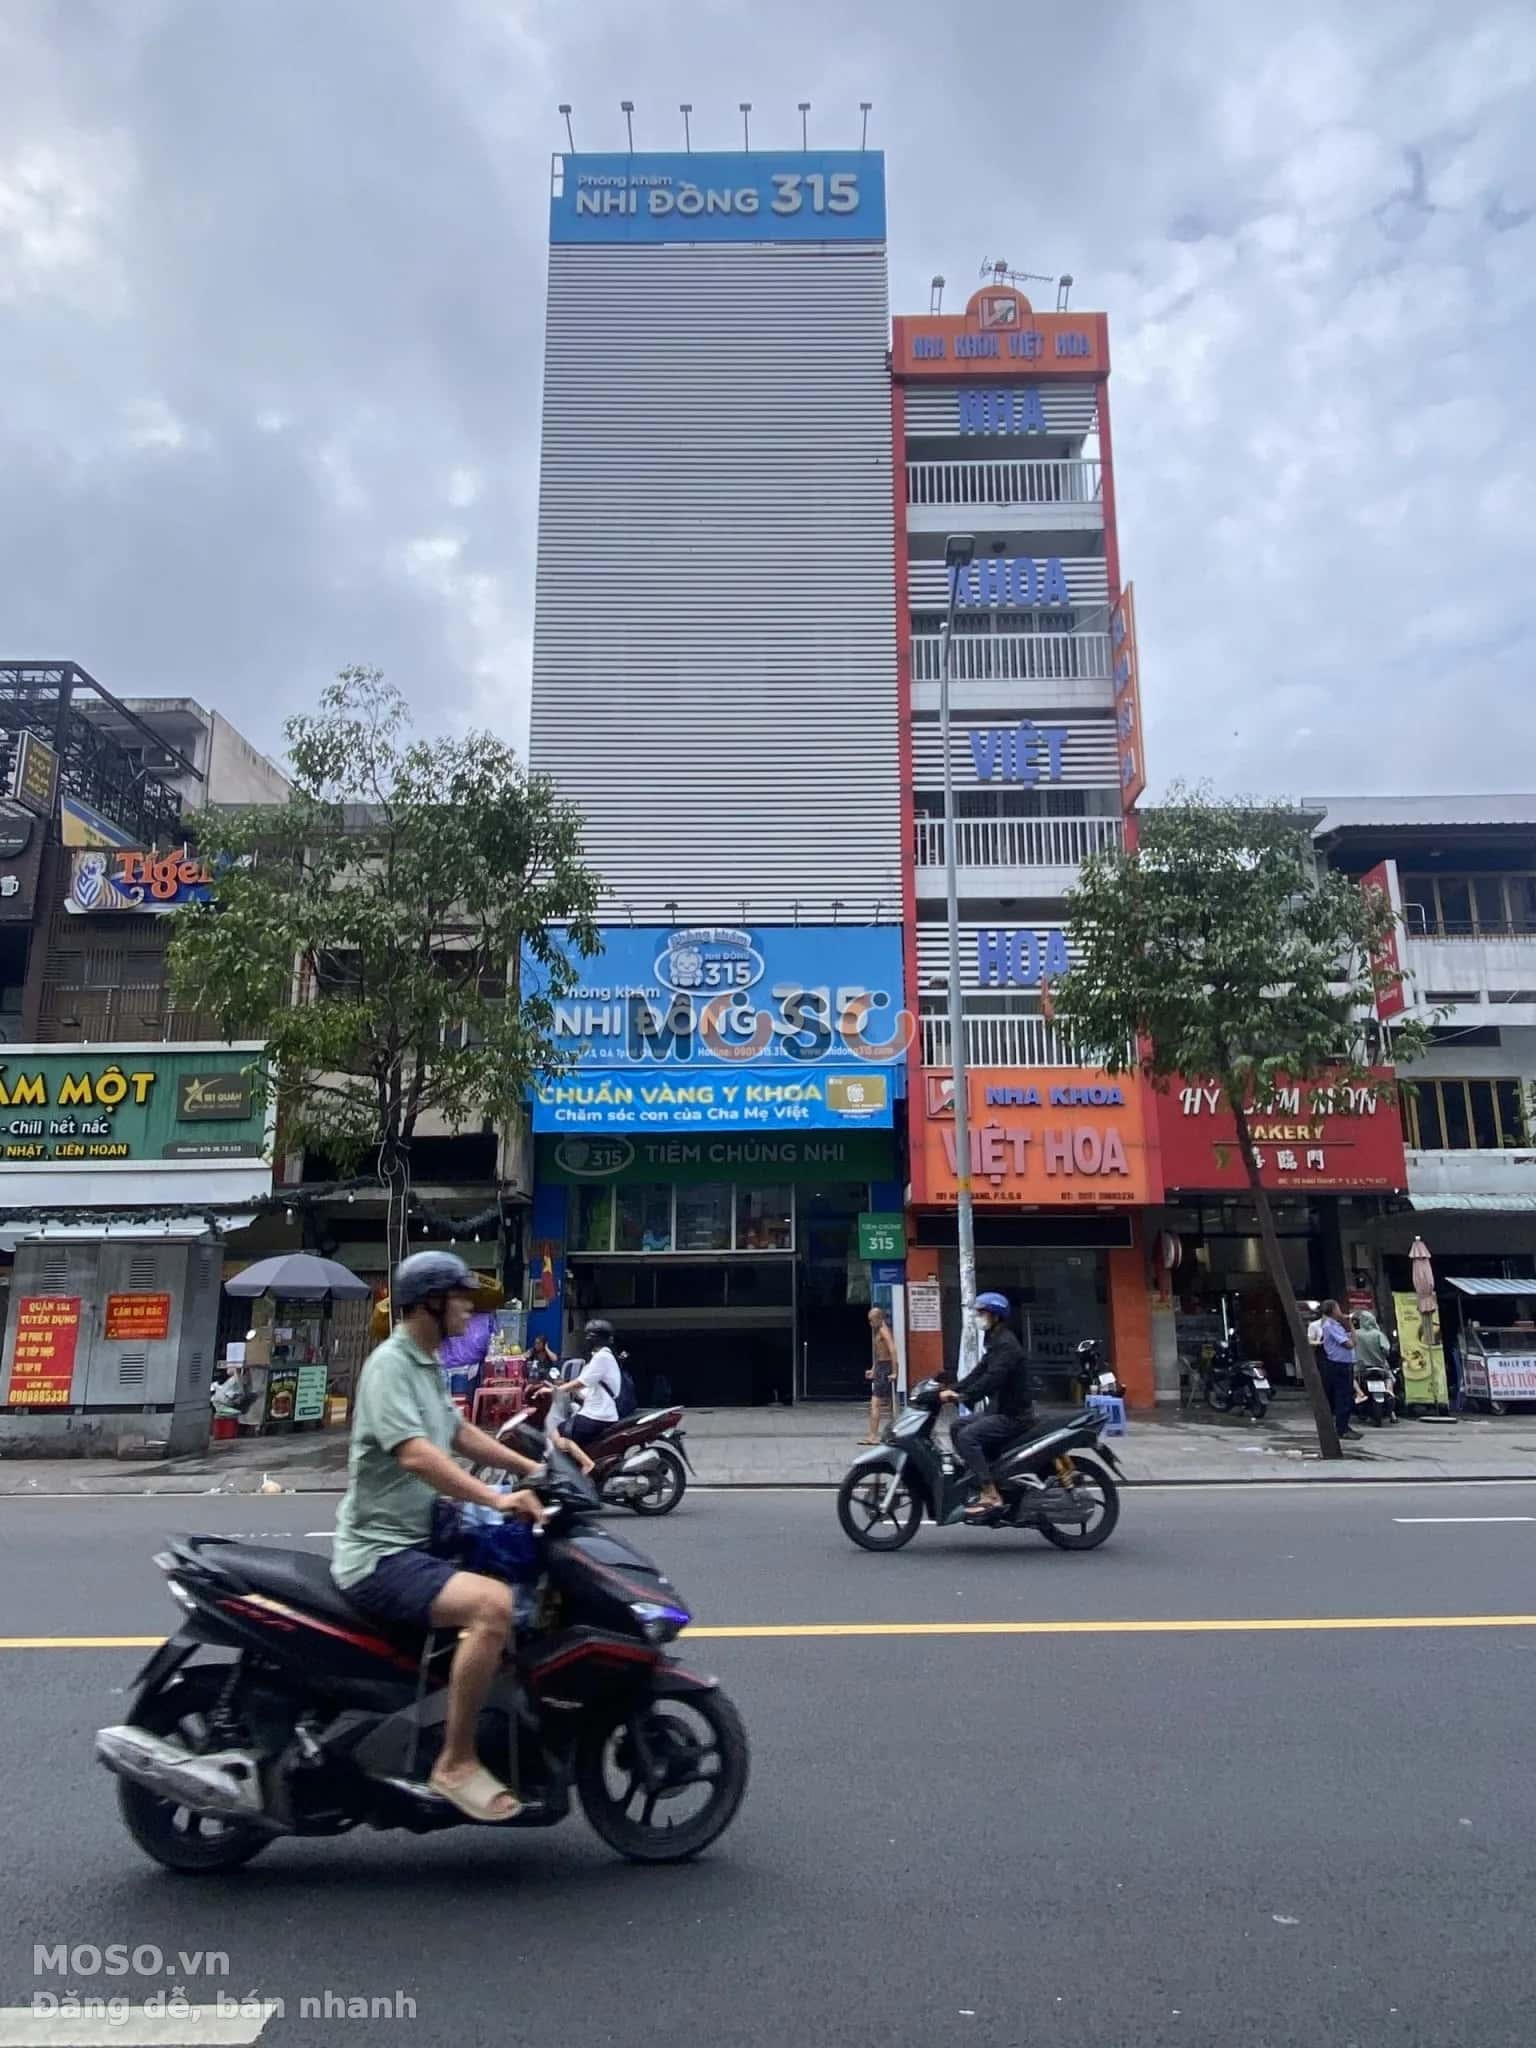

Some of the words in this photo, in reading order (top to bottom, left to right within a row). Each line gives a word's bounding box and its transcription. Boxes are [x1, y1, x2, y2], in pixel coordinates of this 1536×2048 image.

[576, 189, 637, 213] NHI
[648, 180, 759, 213] ĐỒNG
[771, 174, 860, 213] 315
[959, 385, 1047, 433] NHA
[948, 558, 1069, 606] KHOA
[968, 718, 1068, 790] VIỆT
[977, 928, 1070, 986] HOA
[705, 961, 751, 985] 315
[555, 1005, 621, 1035] NHI
[772, 984, 868, 1035] 315
[58, 1065, 155, 1112] MỘT
[640, 1082, 713, 1104] VÀNG
[722, 1086, 740, 1102] Y
[746, 1083, 822, 1102] KHOA
[986, 1086, 1041, 1106] NHA
[1051, 1086, 1124, 1106] KHOA
[49, 1115, 76, 1134] hết
[81, 1116, 109, 1134] nấc
[555, 1108, 603, 1121] Chăm
[608, 1107, 635, 1121] sóc
[640, 1109, 667, 1121] con
[673, 1107, 701, 1120] của
[707, 1107, 739, 1120] Cha
[744, 1107, 769, 1122] Mẹ
[774, 1105, 809, 1119] Việt
[1249, 1124, 1324, 1141] AKERY
[55, 1141, 85, 1157] LIÊN
[89, 1144, 128, 1156] HOAN
[645, 1140, 700, 1163] TIÊM
[710, 1138, 797, 1163] CHỦNG
[804, 1143, 844, 1162] NHI
[941, 1118, 1032, 1185] VIỆT
[1045, 1125, 1129, 1176] HOA
[868, 1237, 895, 1250] 315
